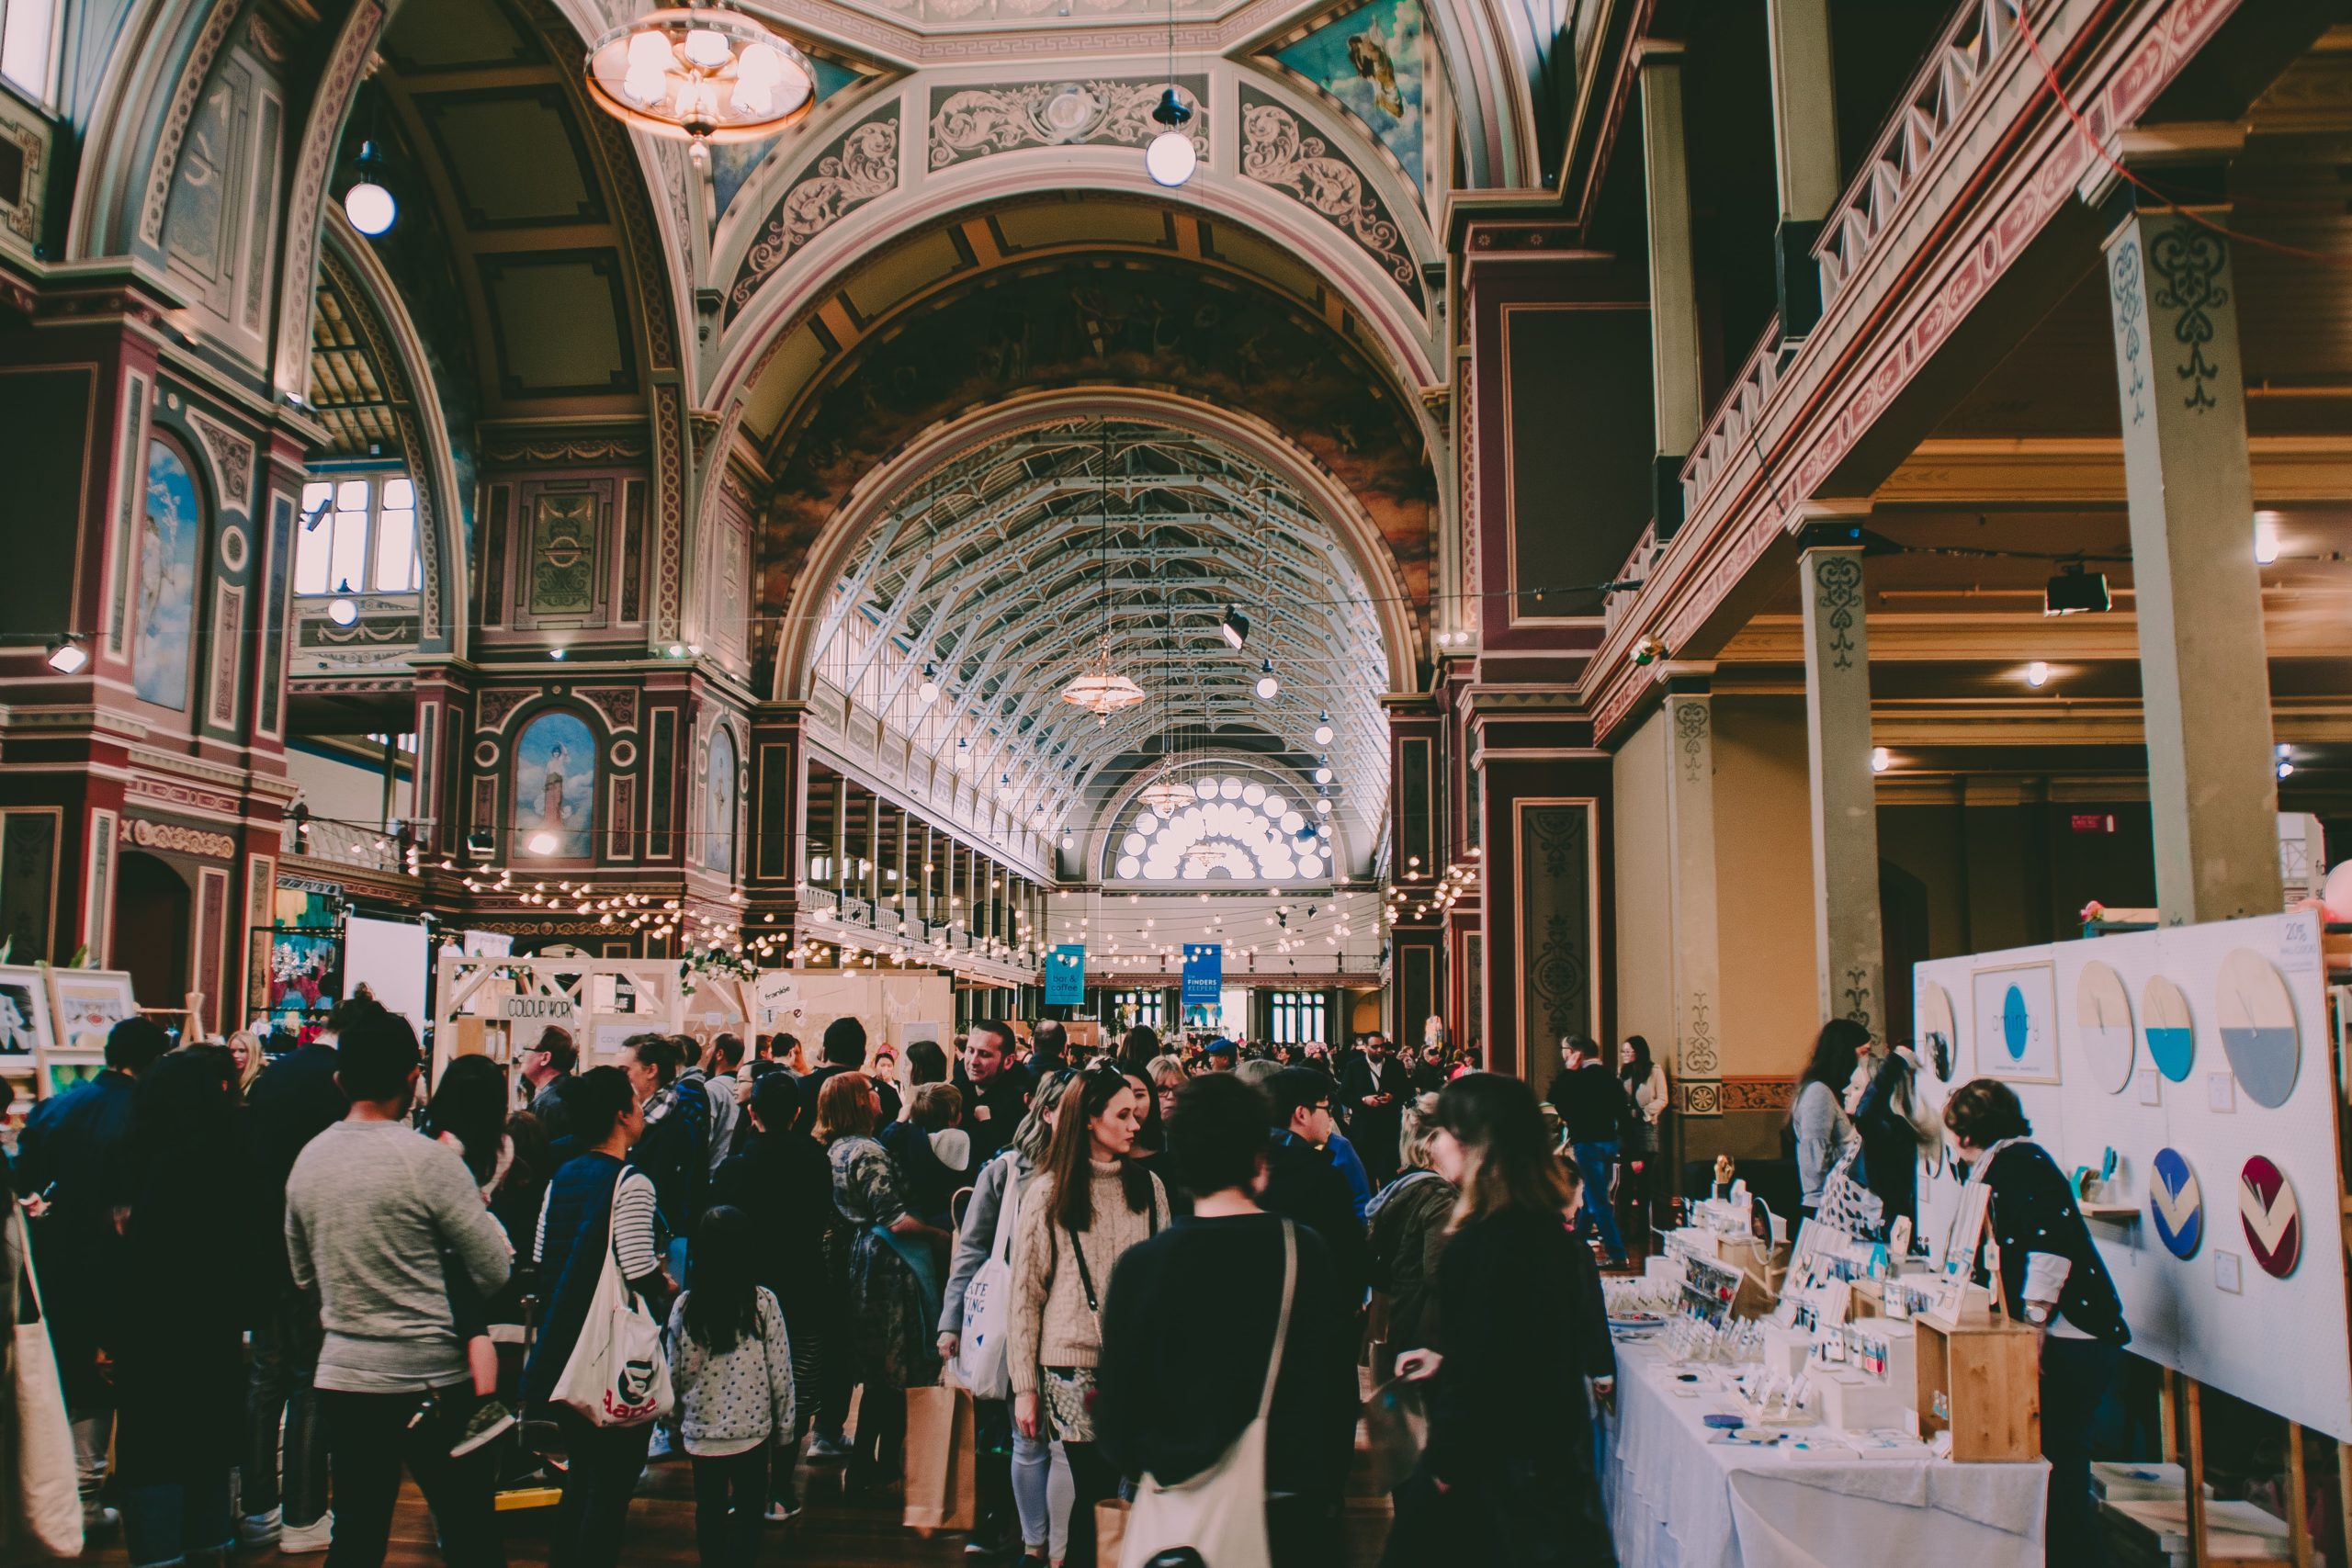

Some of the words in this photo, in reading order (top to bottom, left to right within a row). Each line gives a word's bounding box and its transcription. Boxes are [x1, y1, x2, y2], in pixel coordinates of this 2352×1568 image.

[764, 986, 790, 1000] frankie
[1051, 984, 1079, 992] coffee
[508, 998, 547, 1018] COLOUR
[548, 1000, 574, 1019] WORK
